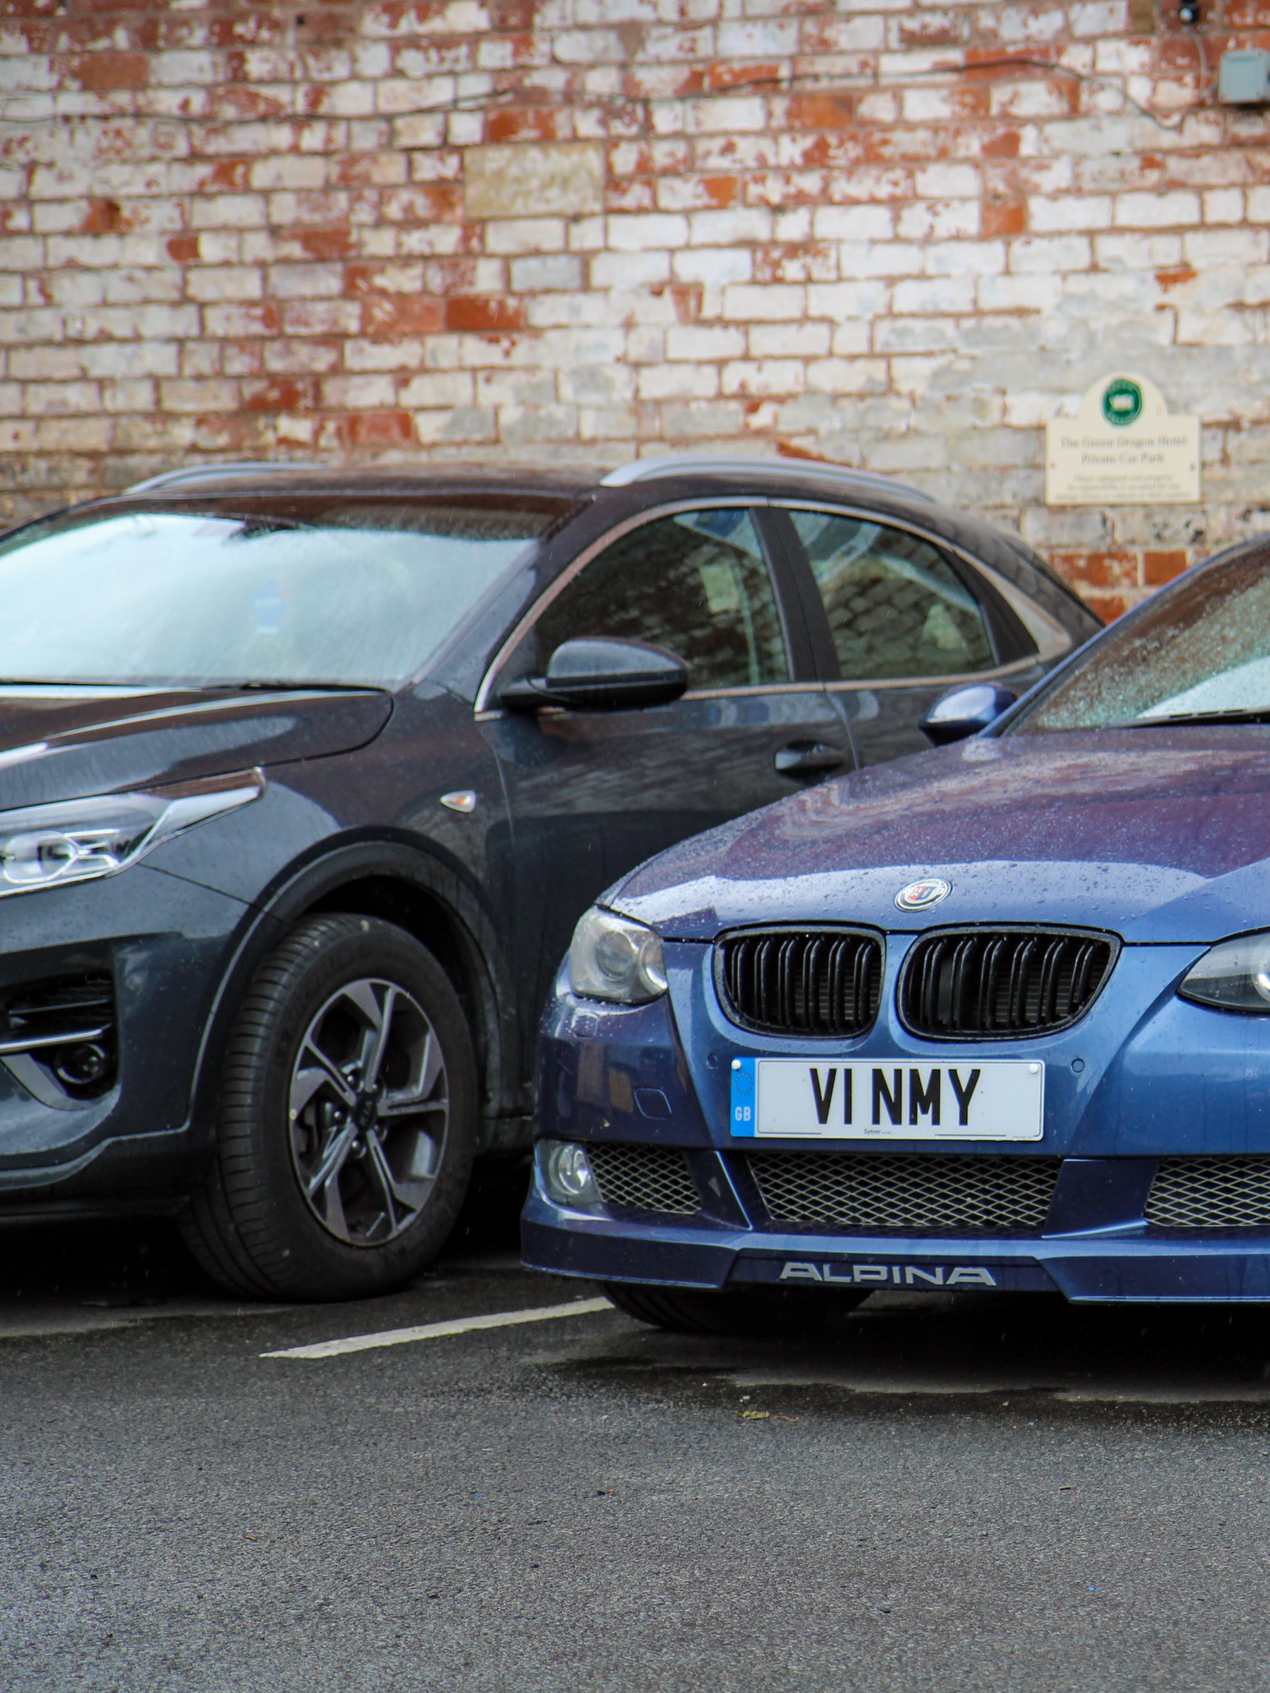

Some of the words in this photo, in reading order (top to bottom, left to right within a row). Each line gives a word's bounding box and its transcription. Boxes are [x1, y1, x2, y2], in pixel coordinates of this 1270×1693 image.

[871, 1068, 981, 1126] NMY
[734, 1106, 751, 1122] GB
[779, 1261, 997, 1287] ALPINA
